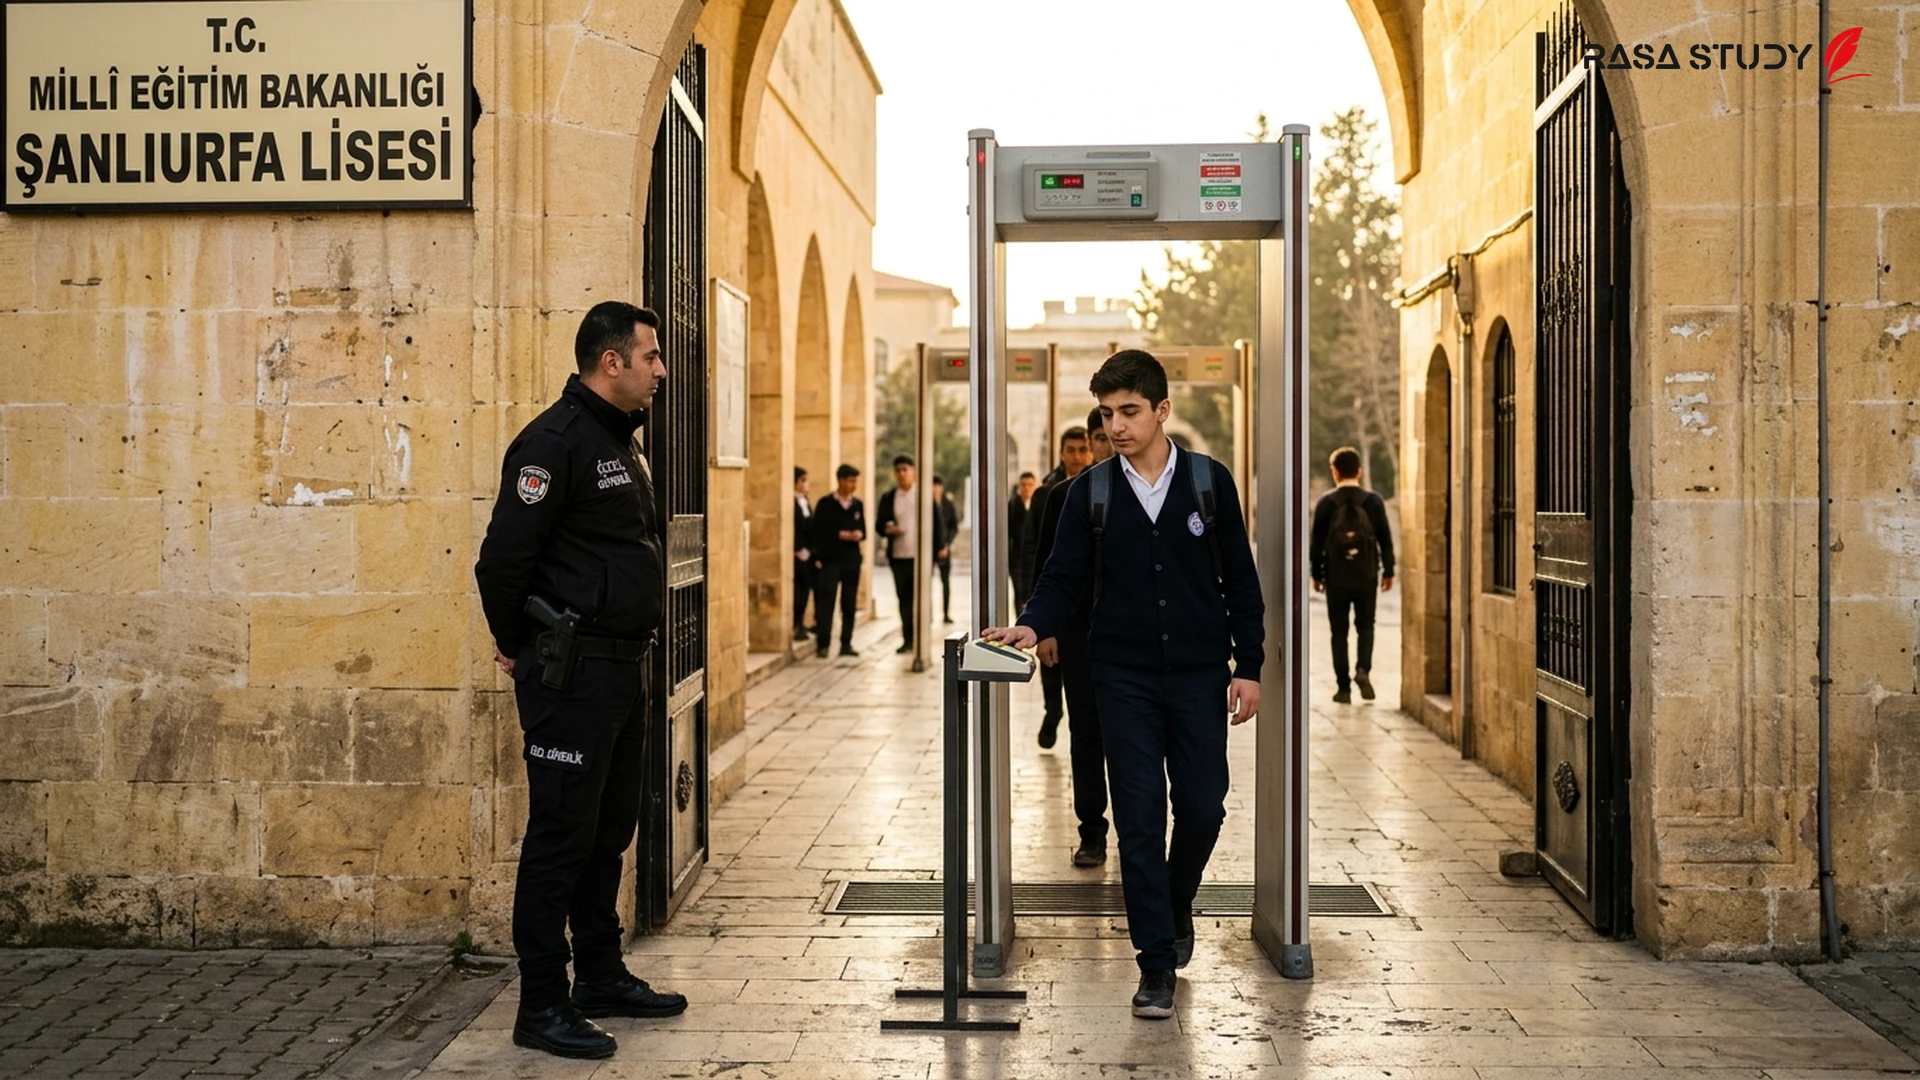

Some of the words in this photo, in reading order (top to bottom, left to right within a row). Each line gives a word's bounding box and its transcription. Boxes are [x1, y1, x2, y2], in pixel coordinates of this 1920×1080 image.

[206, 17, 266, 53] T.C.
[29, 66, 119, 111] MİLLÎ
[131, 65, 248, 110] EĞİTİM
[260, 63, 444, 109] BAKANLIĞI
[15, 132, 286, 198] ŞANLIURFA
[302, 117, 451, 181] LİSESİ
